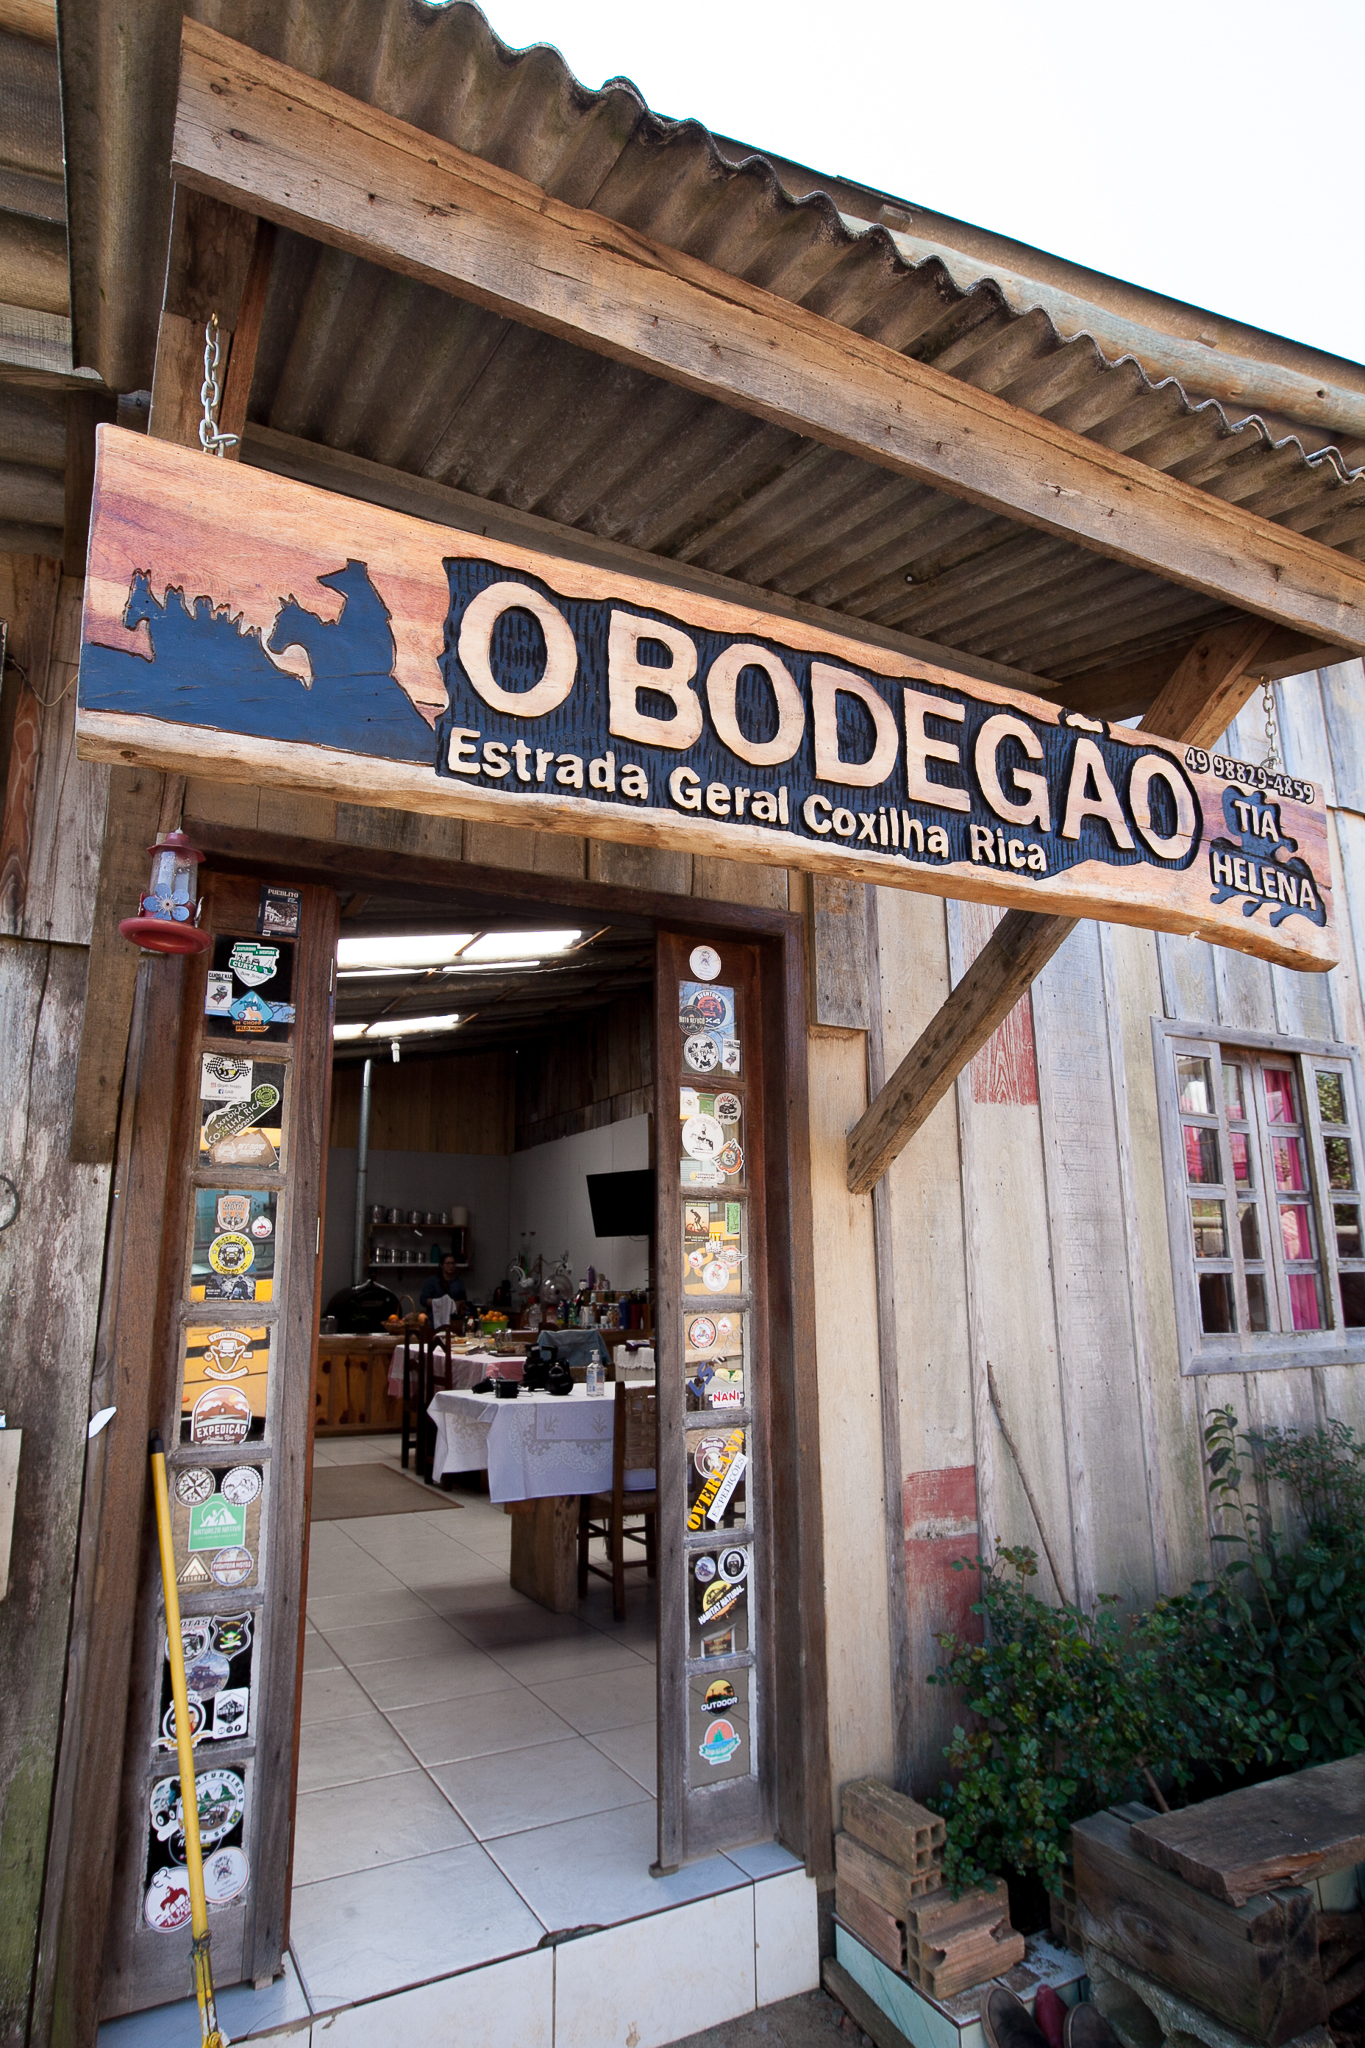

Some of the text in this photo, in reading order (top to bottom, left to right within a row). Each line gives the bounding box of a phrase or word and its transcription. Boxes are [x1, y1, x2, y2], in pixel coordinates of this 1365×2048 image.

[458, 581, 1197, 860] O BODEGÃO
[1184, 747, 1316, 804] 49 98829-4859
[448, 727, 1048, 873] Estrada Geral Coxilha Rica
[1211, 801, 1318, 912] TIA HELENA
[232, 961, 258, 972] CURTA
[697, 990, 722, 1003] AVENTURA
[215, 1102, 247, 1129] EXPEDIÇÃO
[243, 1100, 263, 1116] RICA
[211, 1332, 250, 1343] TROPEIROS
[688, 1361, 714, 1397] LS
[711, 1324, 744, 1365] Tractor
[713, 1390, 740, 1402] NANI
[687, 1429, 745, 1530] OVERLAND
[711, 1456, 745, 1518] EXPEDIÇÕES
[193, 1525, 241, 1536] NATUREZA NATIVA
[700, 1696, 738, 1712] OUTDOOR
